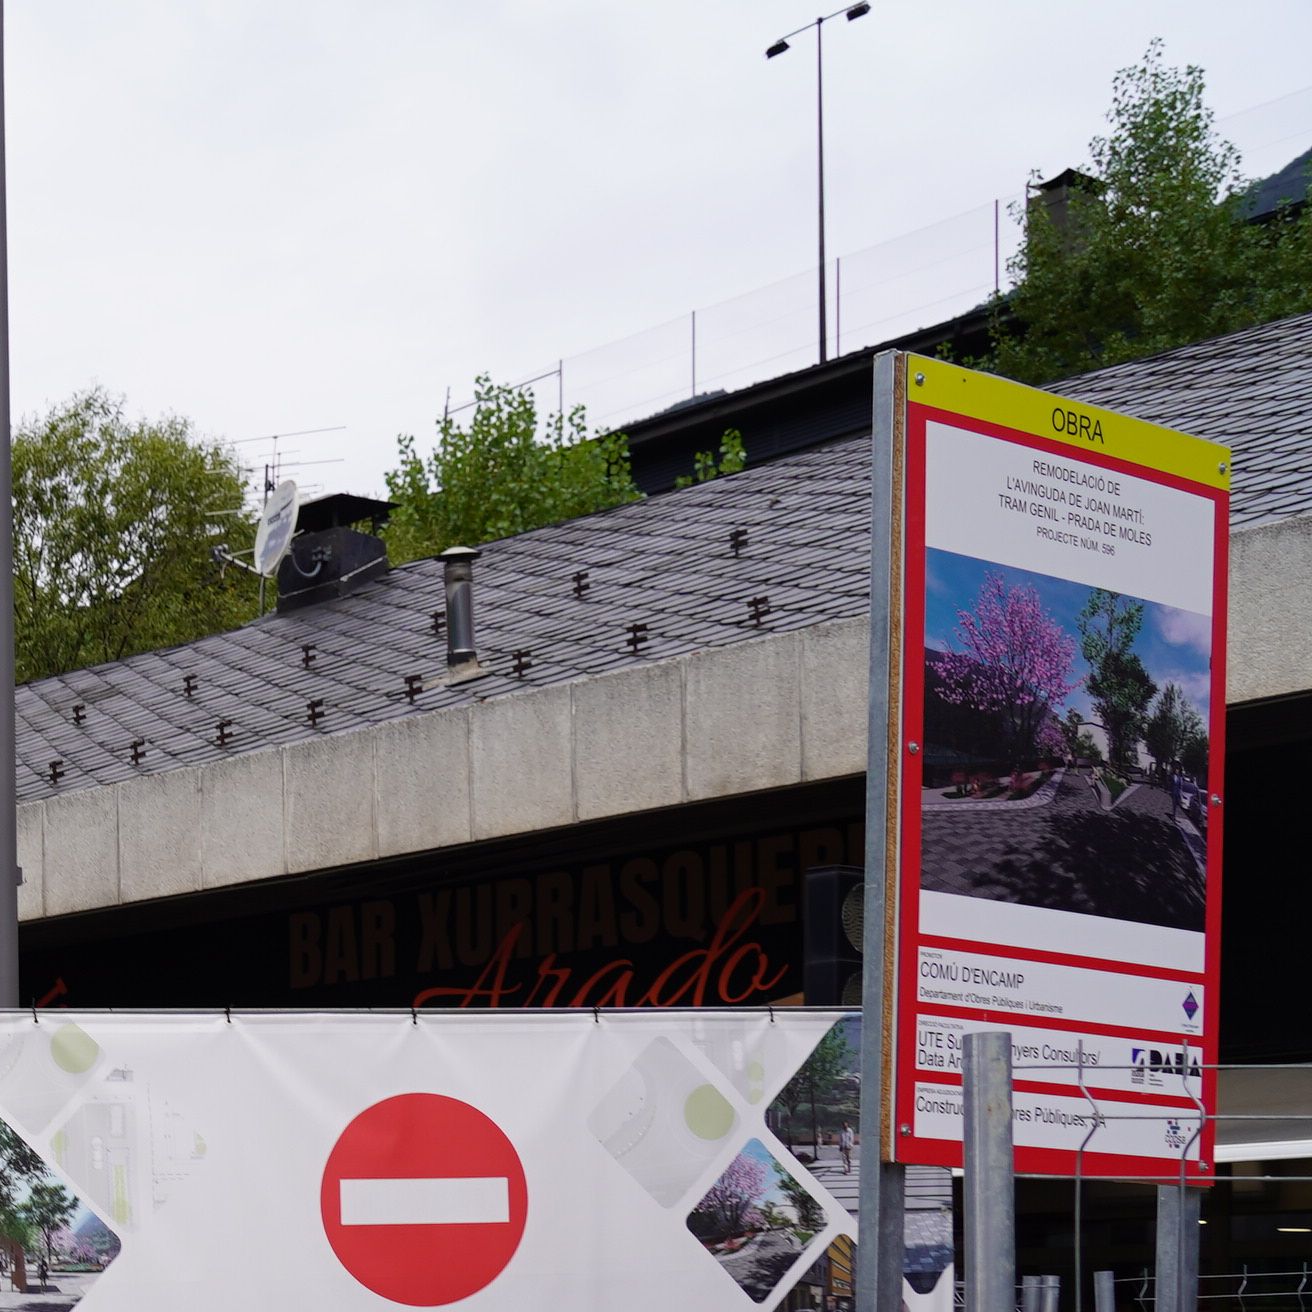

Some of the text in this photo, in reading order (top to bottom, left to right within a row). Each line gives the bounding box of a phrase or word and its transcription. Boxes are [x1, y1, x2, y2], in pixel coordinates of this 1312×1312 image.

[1051, 407, 1105, 445] OBRA
[1006, 475, 1066, 504] L'AVINGUDA
[1068, 492, 1083, 508] DE
[1084, 498, 1111, 516] JOAN
[1032, 460, 1121, 496] REMODELACIÓ DE
[999, 494, 1027, 513] TRAM
[1029, 502, 1059, 522] GENIL
[1067, 512, 1102, 533] PRADA
[1103, 522, 1117, 537] DE
[1118, 526, 1152, 547] MOLES
[1036, 526, 1078, 547] PROJECTE
[287, 822, 864, 991] BAR XURRASQUE
[413, 886, 793, 1007] Arado
[919, 961, 1025, 990] COMÚ D'ENCAMP
[919, 986, 964, 1002] Departament
[964, 992, 991, 1006] d'Obres
[992, 995, 1024, 1010] Públiques
[1028, 1001, 1064, 1014] Urbanisme
[918, 1031, 943, 1048] UTE
[1011, 1044, 1039, 1061] nyers
[1042, 1044, 1101, 1066] Consulors/
[918, 1049, 945, 1067] Data
